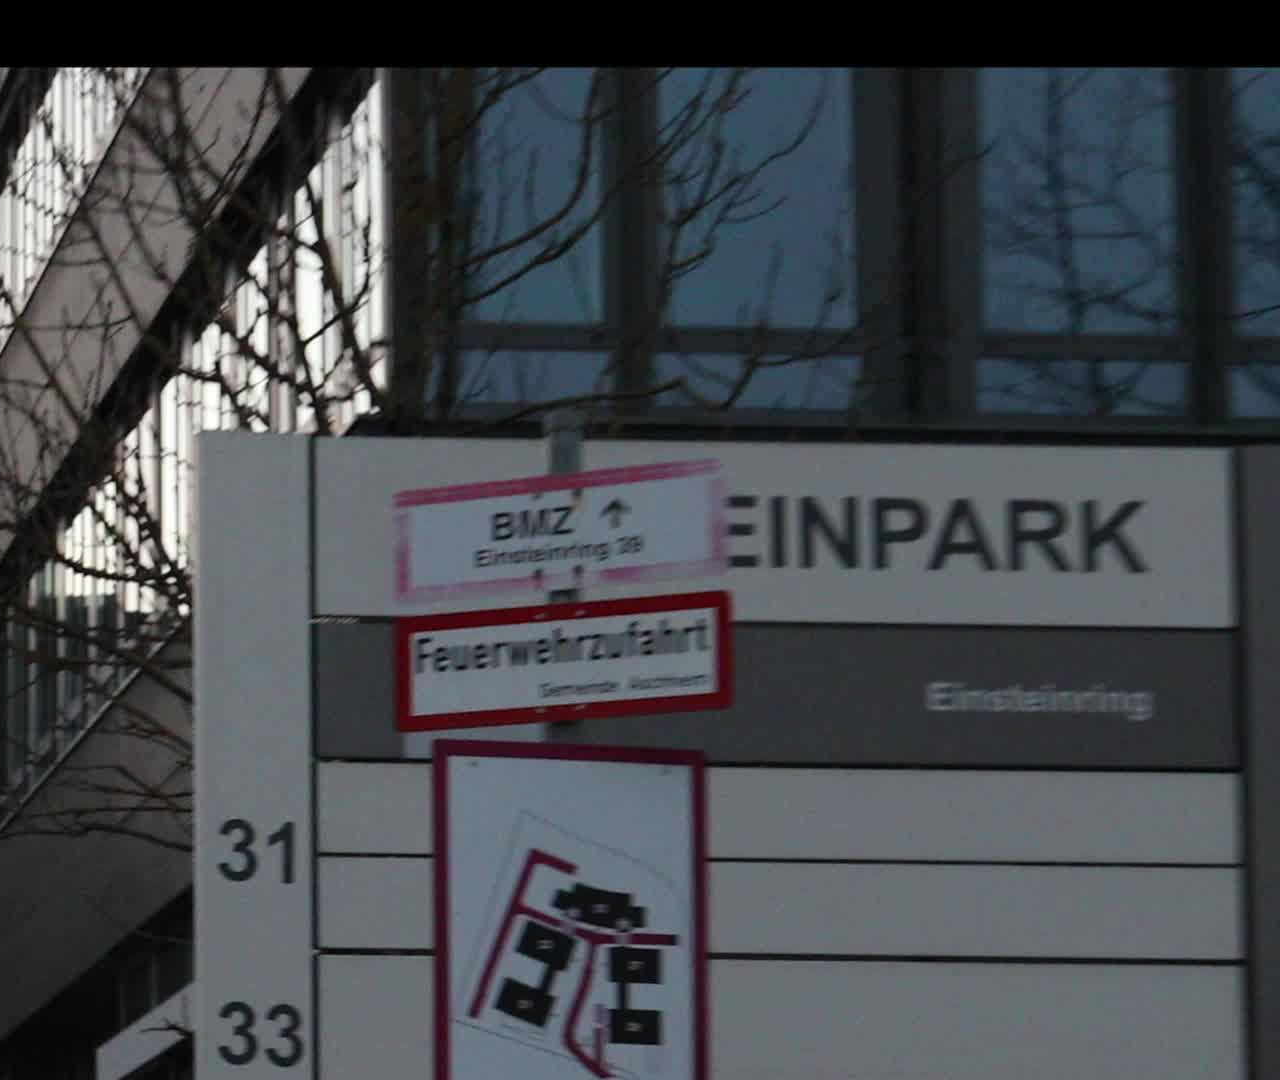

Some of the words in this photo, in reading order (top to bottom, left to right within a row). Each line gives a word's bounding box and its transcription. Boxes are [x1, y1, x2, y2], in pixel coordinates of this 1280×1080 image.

[491, 505, 574, 541] BMZ
[474, 540, 608, 568] Einsteinring
[414, 617, 708, 674] Feuerwehrzufahrt
[925, 681, 1154, 722] Einsteinring
[218, 819, 296, 884] 31
[218, 1002, 305, 1068] 33
